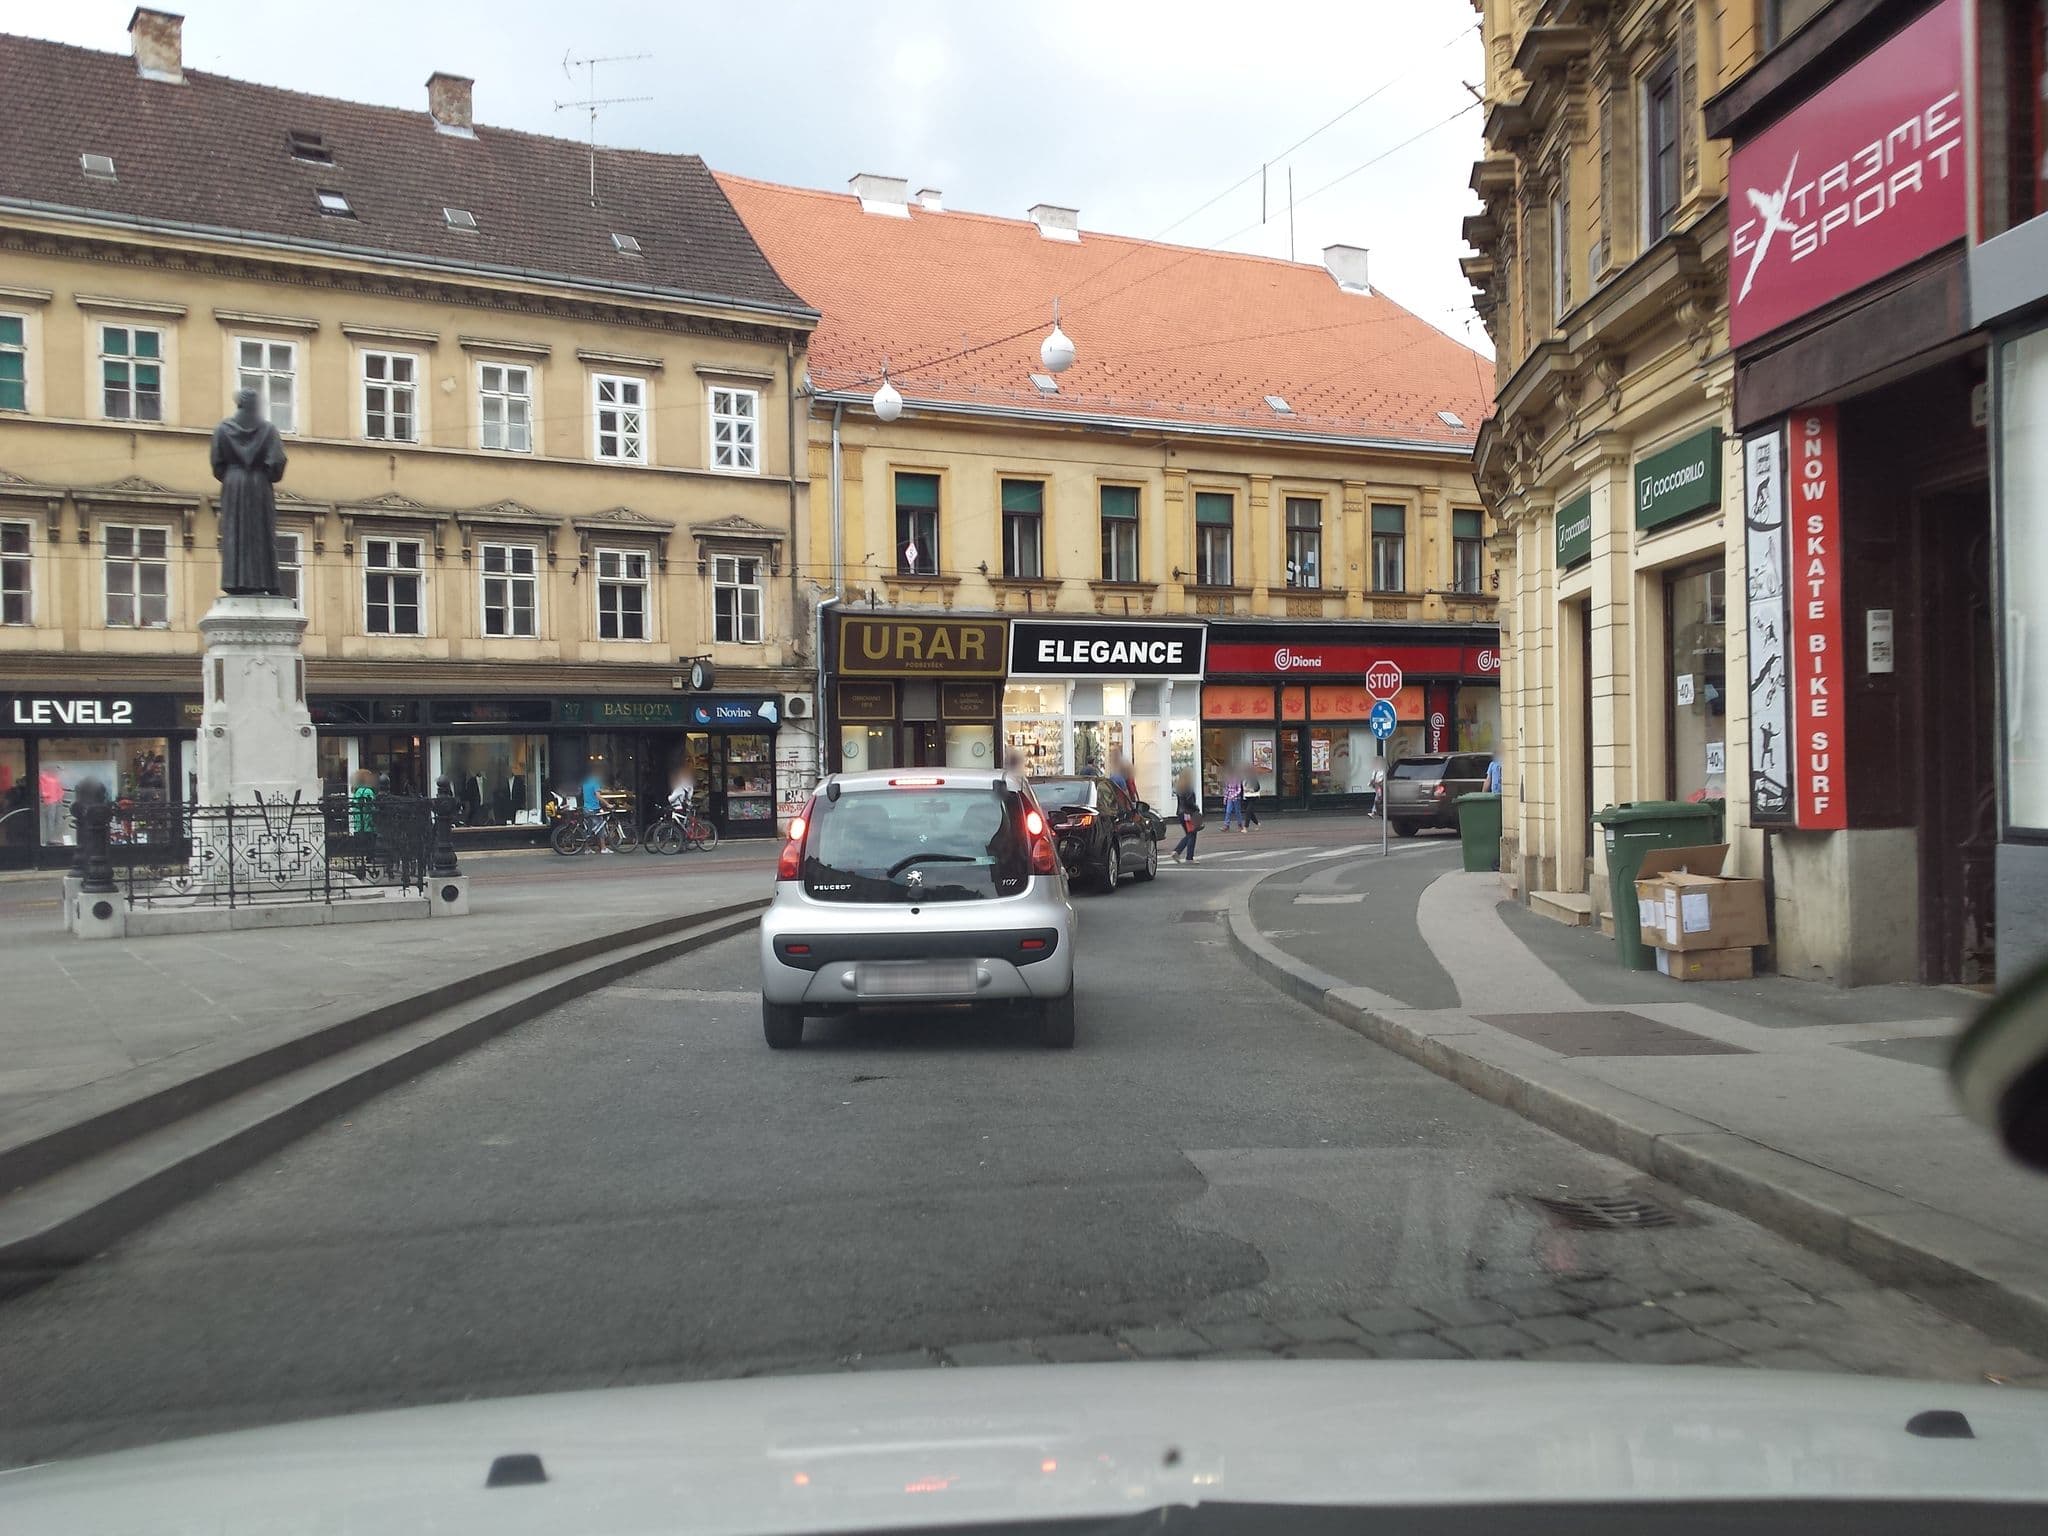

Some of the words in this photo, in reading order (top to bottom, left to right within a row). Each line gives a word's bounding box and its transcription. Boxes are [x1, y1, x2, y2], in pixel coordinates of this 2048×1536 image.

[1791, 136, 1961, 263] SPORT
[1802, 417, 1826, 501] SNOW
[1653, 460, 1705, 498] COCCODRILLO
[1807, 515, 1826, 620] SKATE
[862, 625, 986, 661] URAR
[1038, 639, 1183, 665] ELEGANCE
[1292, 655, 1322, 668] Diona
[1808, 634, 1828, 718] BIKE
[1369, 673, 1399, 689] STOP
[13, 700, 133, 724] LEVEL2
[605, 703, 673, 716] BASHOTA
[1811, 731, 1830, 815] SURF
[813, 883, 852, 891] PEUGEOT
[1001, 878, 1018, 887] 107
